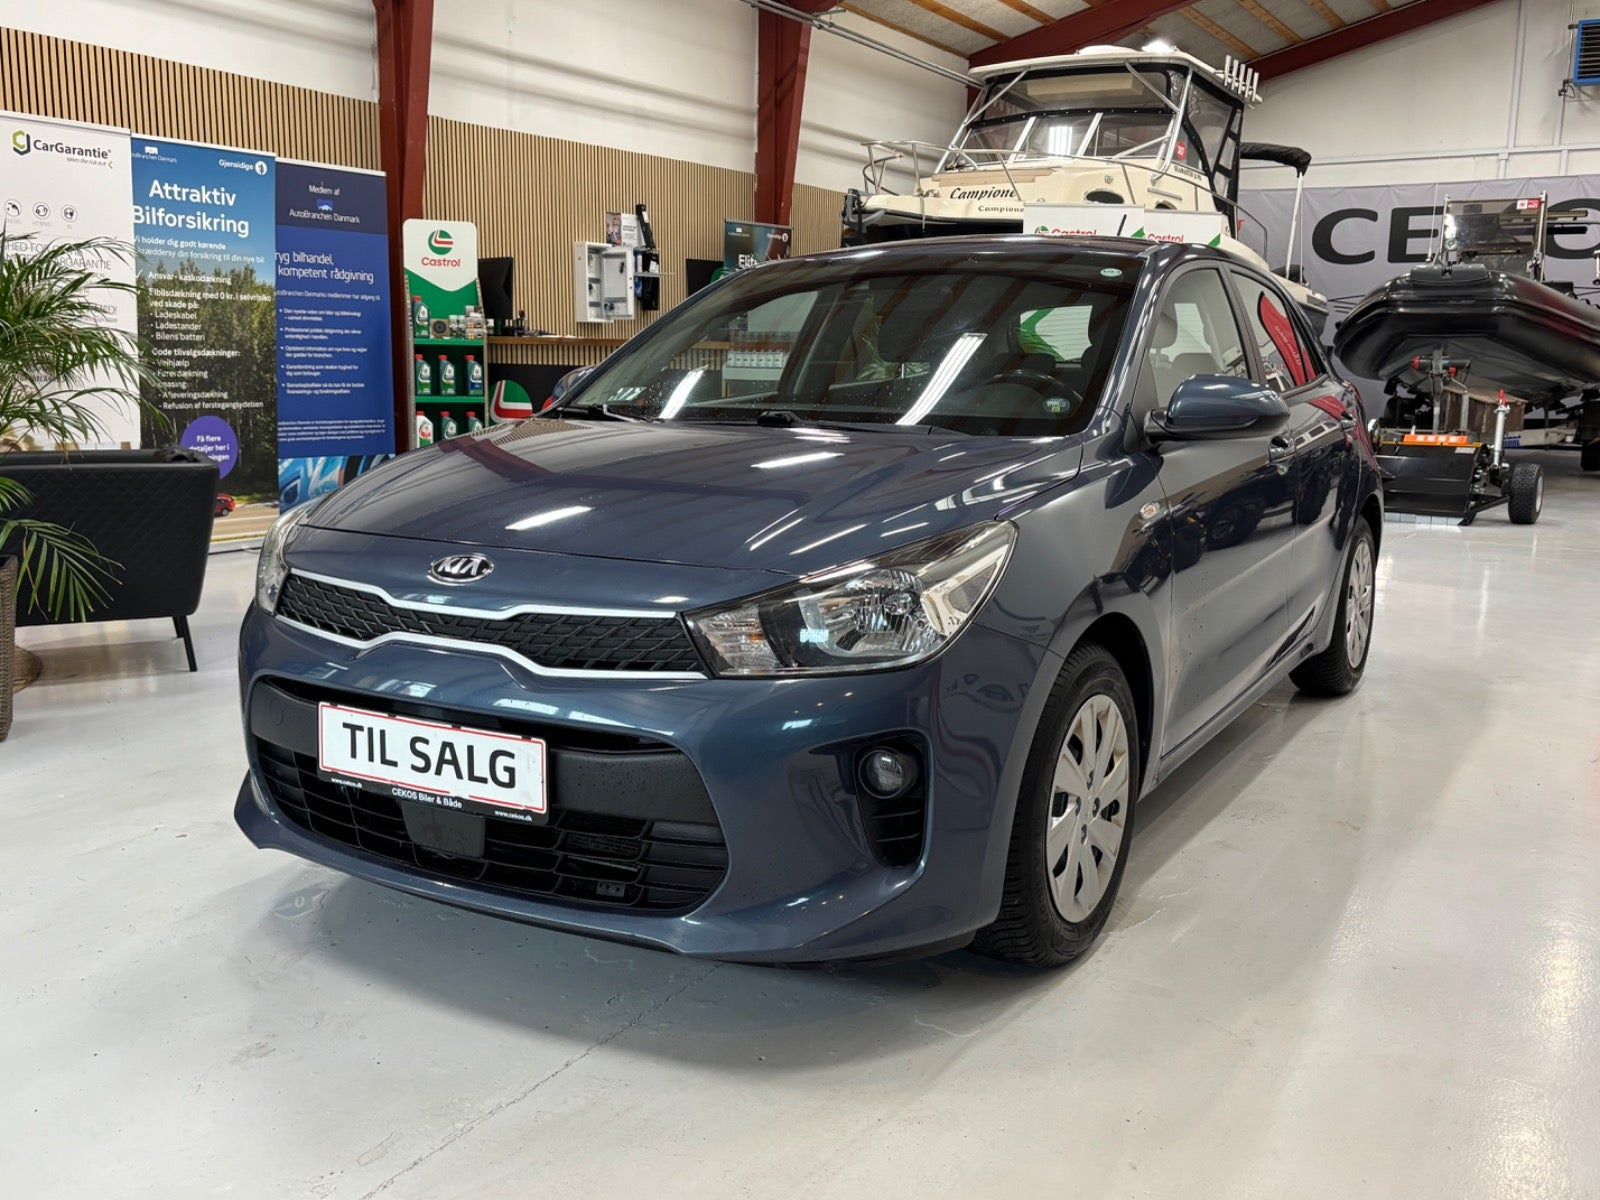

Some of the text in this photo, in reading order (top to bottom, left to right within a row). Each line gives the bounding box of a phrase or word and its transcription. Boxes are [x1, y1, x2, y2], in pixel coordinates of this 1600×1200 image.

[33, 139, 109, 160] CarGarantie
[149, 179, 237, 207] Attraktiv
[308, 184, 333, 195] Medlem
[132, 205, 249, 239] Bilforsikring
[333, 213, 361, 224] Danmark
[141, 236, 166, 245] holder
[167, 238, 179, 248] dig
[179, 239, 197, 249] godt
[197, 240, 226, 250] kørende
[177, 250, 189, 258] din
[189, 250, 222, 262] forsikring
[222, 253, 231, 262] til
[231, 254, 243, 262] din
[243, 255, 255, 264] nye
[421, 256, 461, 267] Castrol
[278, 265, 374, 285] kompetent rådgivning
[202, 292, 219, 301] med
[219, 292, 225, 300] 0
[225, 292, 236, 301] kr.
[239, 294, 272, 302] selvrisiko
[149, 300, 164, 308] ved
[164, 301, 187, 309] skade
[155, 311, 198, 321] Ladeskabel
[155, 321, 202, 331] Ladestander
[155, 333, 205, 342] Bilens batteri
[151, 348, 241, 359] Gode tilvalgsdækninger:
[162, 402, 193, 410] Refusion
[196, 435, 205, 443] Få
[342, 722, 516, 789] TIL SALG
[391, 787, 463, 809] CEKOS Biler & Både
[494, 810, 533, 822] www.cekos.dk
